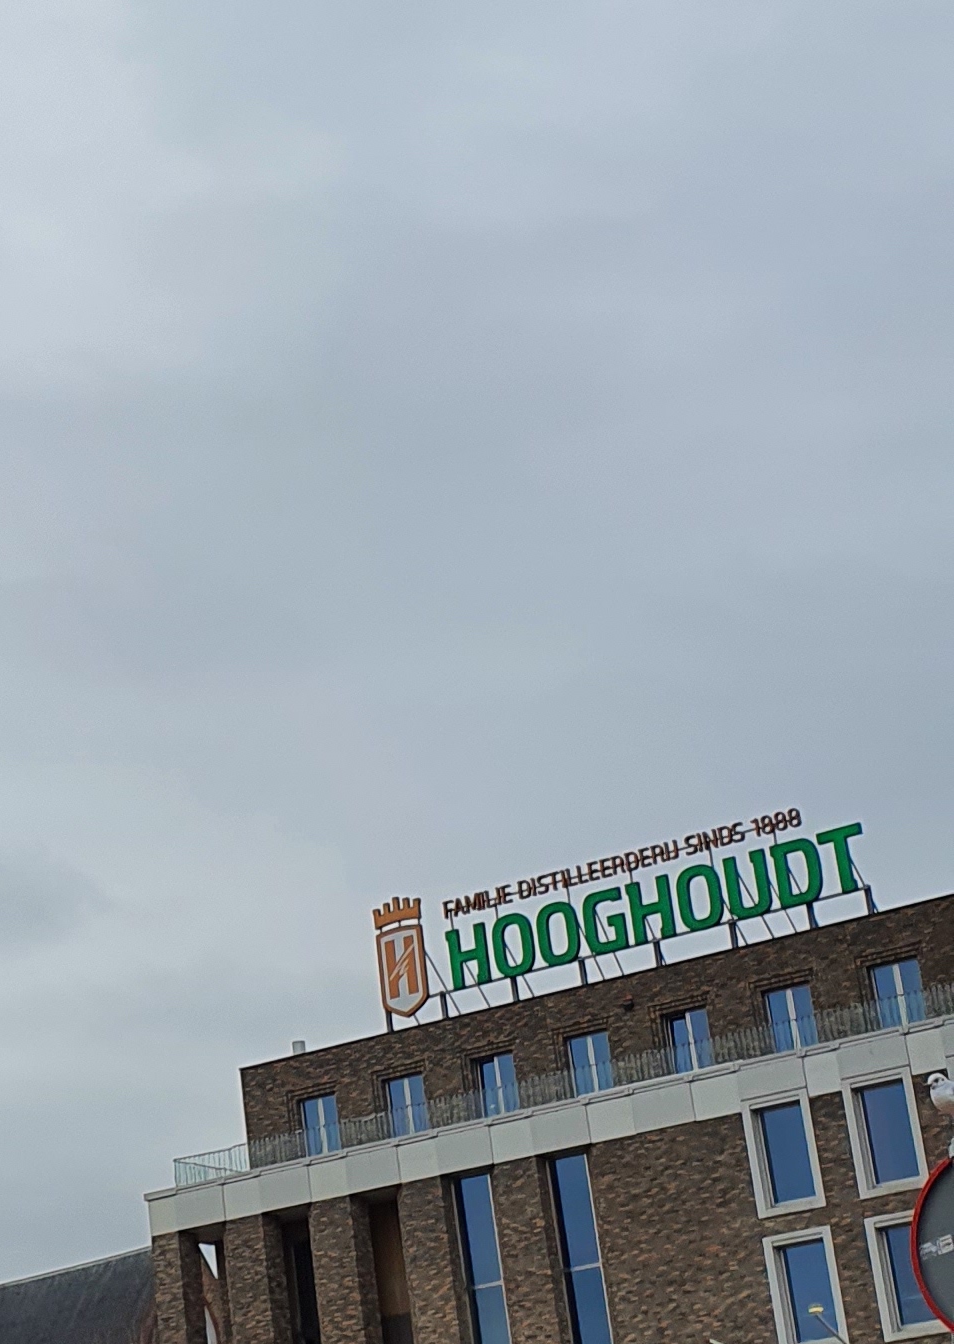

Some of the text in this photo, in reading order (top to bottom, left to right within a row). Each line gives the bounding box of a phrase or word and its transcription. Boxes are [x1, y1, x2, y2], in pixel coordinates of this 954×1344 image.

[442, 807, 802, 920] FAMILIE DISTILLEERDERIJ SINDS 1888
[445, 822, 863, 990] HOOGHOUDT
